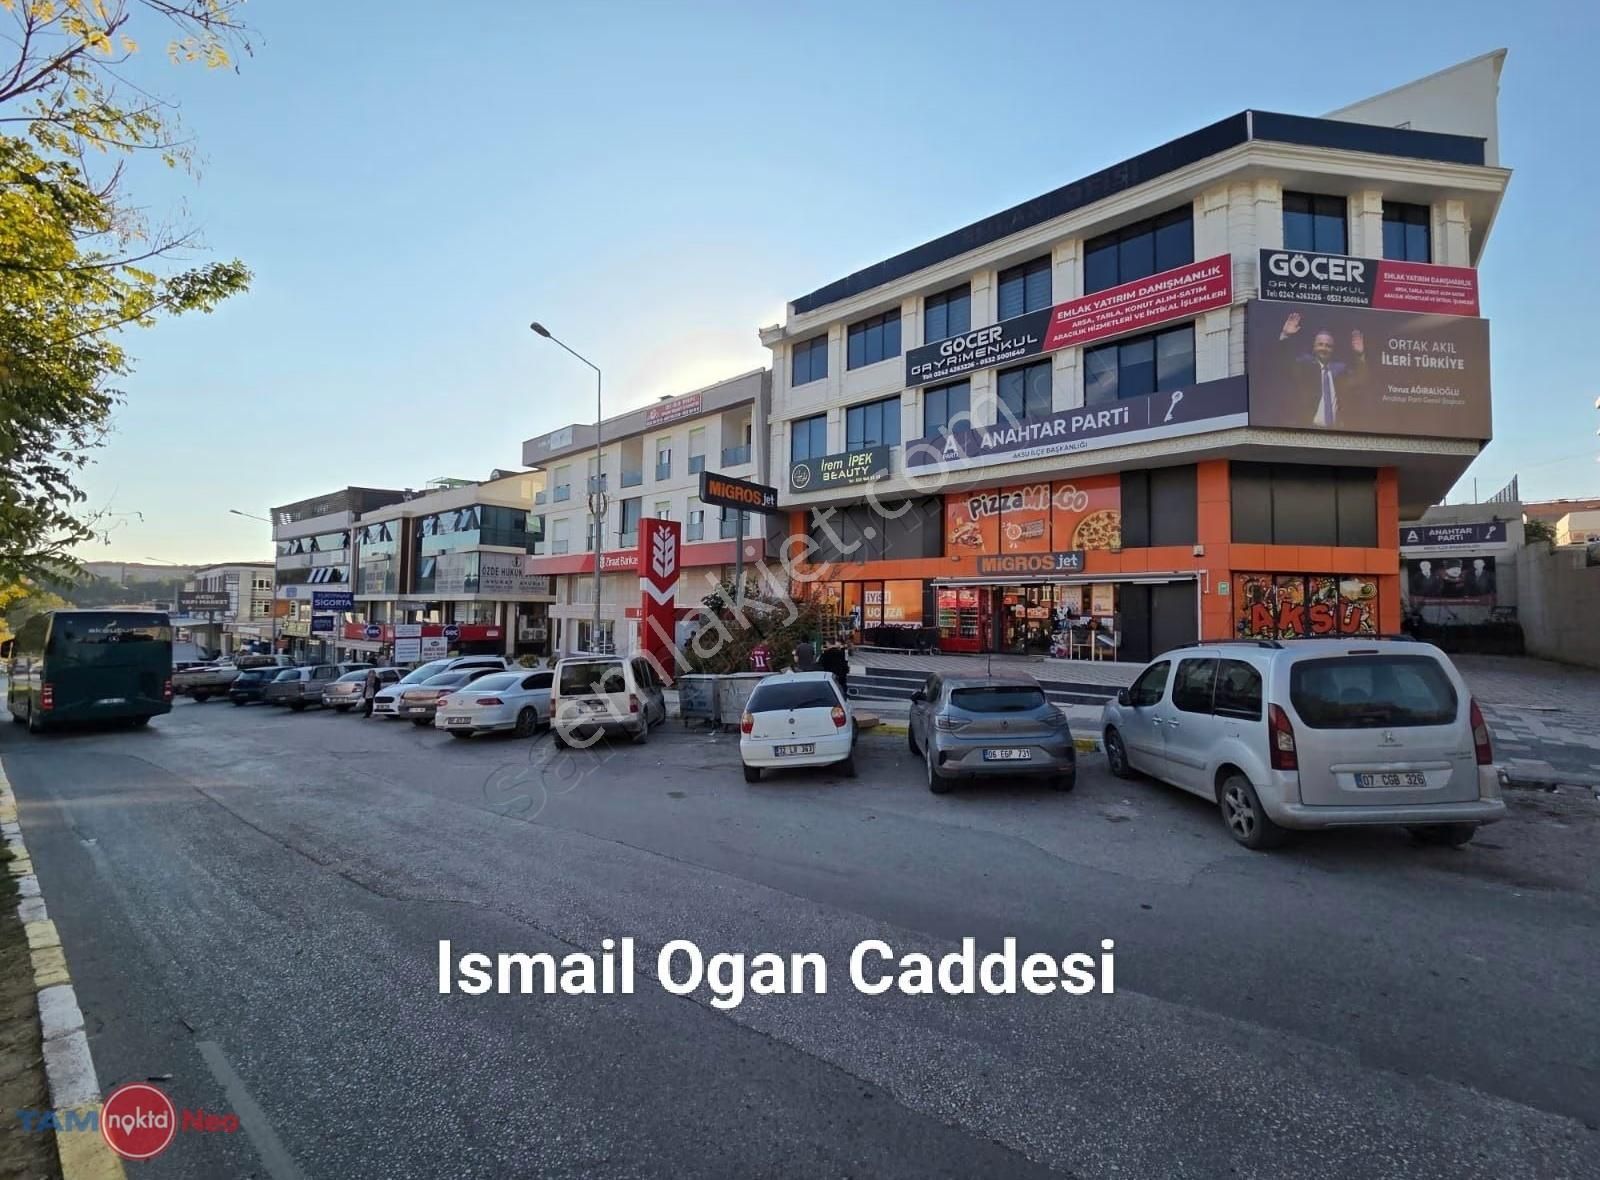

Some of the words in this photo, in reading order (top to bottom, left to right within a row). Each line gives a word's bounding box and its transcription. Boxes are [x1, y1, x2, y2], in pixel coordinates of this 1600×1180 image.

[1057, 304, 1092, 320] EMLAK
[1093, 290, 1136, 309] YATIRIM
[1138, 265, 1221, 297] DANIŞMANLIK
[1125, 300, 1153, 313] KONUT
[1155, 285, 1207, 305] ALIM-SATIM
[1133, 312, 1145, 320] VE
[1388, 338, 1428, 352] ORTAK
[1432, 341, 1457, 354] AKIL
[1381, 351, 1411, 368] İLERİ
[1413, 354, 1465, 370] TÜRKİYE
[981, 420, 1067, 449] ANAHTAR
[823, 466, 869, 481] BEAUTY
[762, 492, 775, 507] jet
[1428, 527, 1473, 536] ANAHTAR
[605, 556, 620, 567] Ziraat
[620, 555, 639, 566] Bankas
[1055, 553, 1078, 570] jet
[1252, 601, 1361, 634] AKSU
[755, 655, 765, 667] 11
[988, 750, 997, 758] 06
[1363, 775, 1374, 786] 07
[1407, 774, 1424, 785] 326
